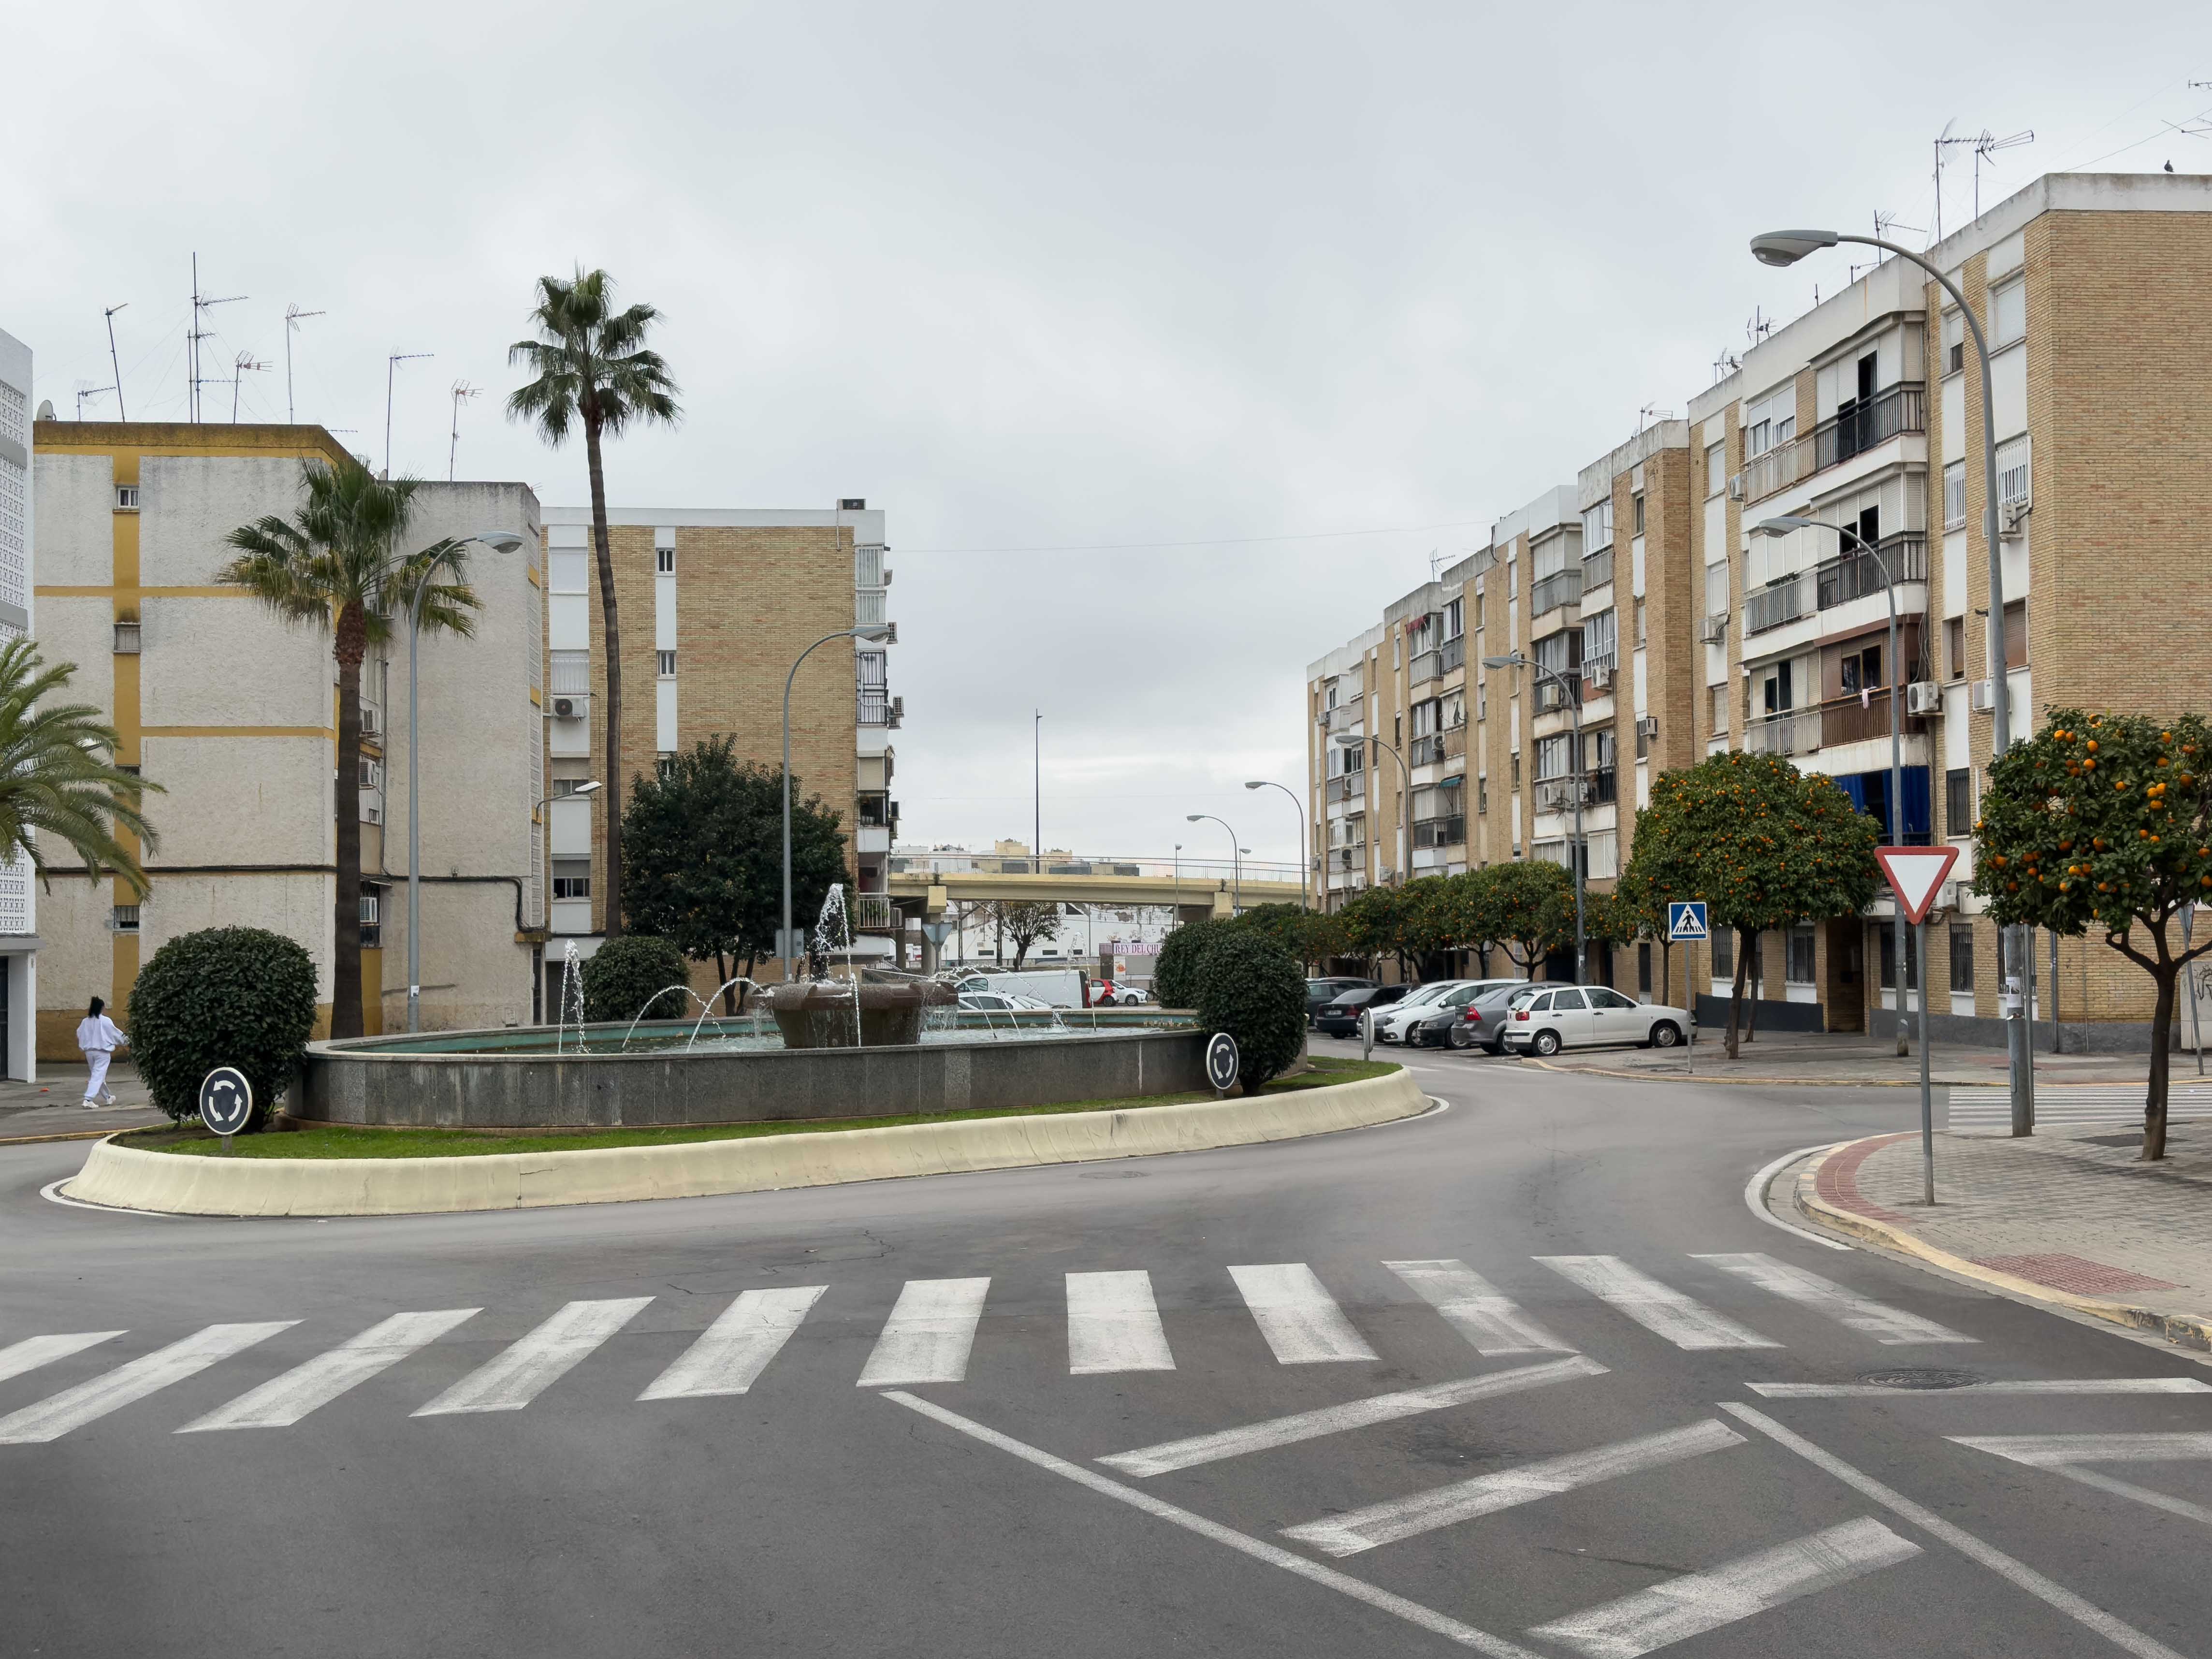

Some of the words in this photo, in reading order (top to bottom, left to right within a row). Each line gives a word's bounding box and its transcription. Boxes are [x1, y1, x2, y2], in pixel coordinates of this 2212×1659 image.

[1115, 944, 1130, 953] REY
[1132, 944, 1146, 953] DEL
[1147, 944, 1161, 953] CHU
